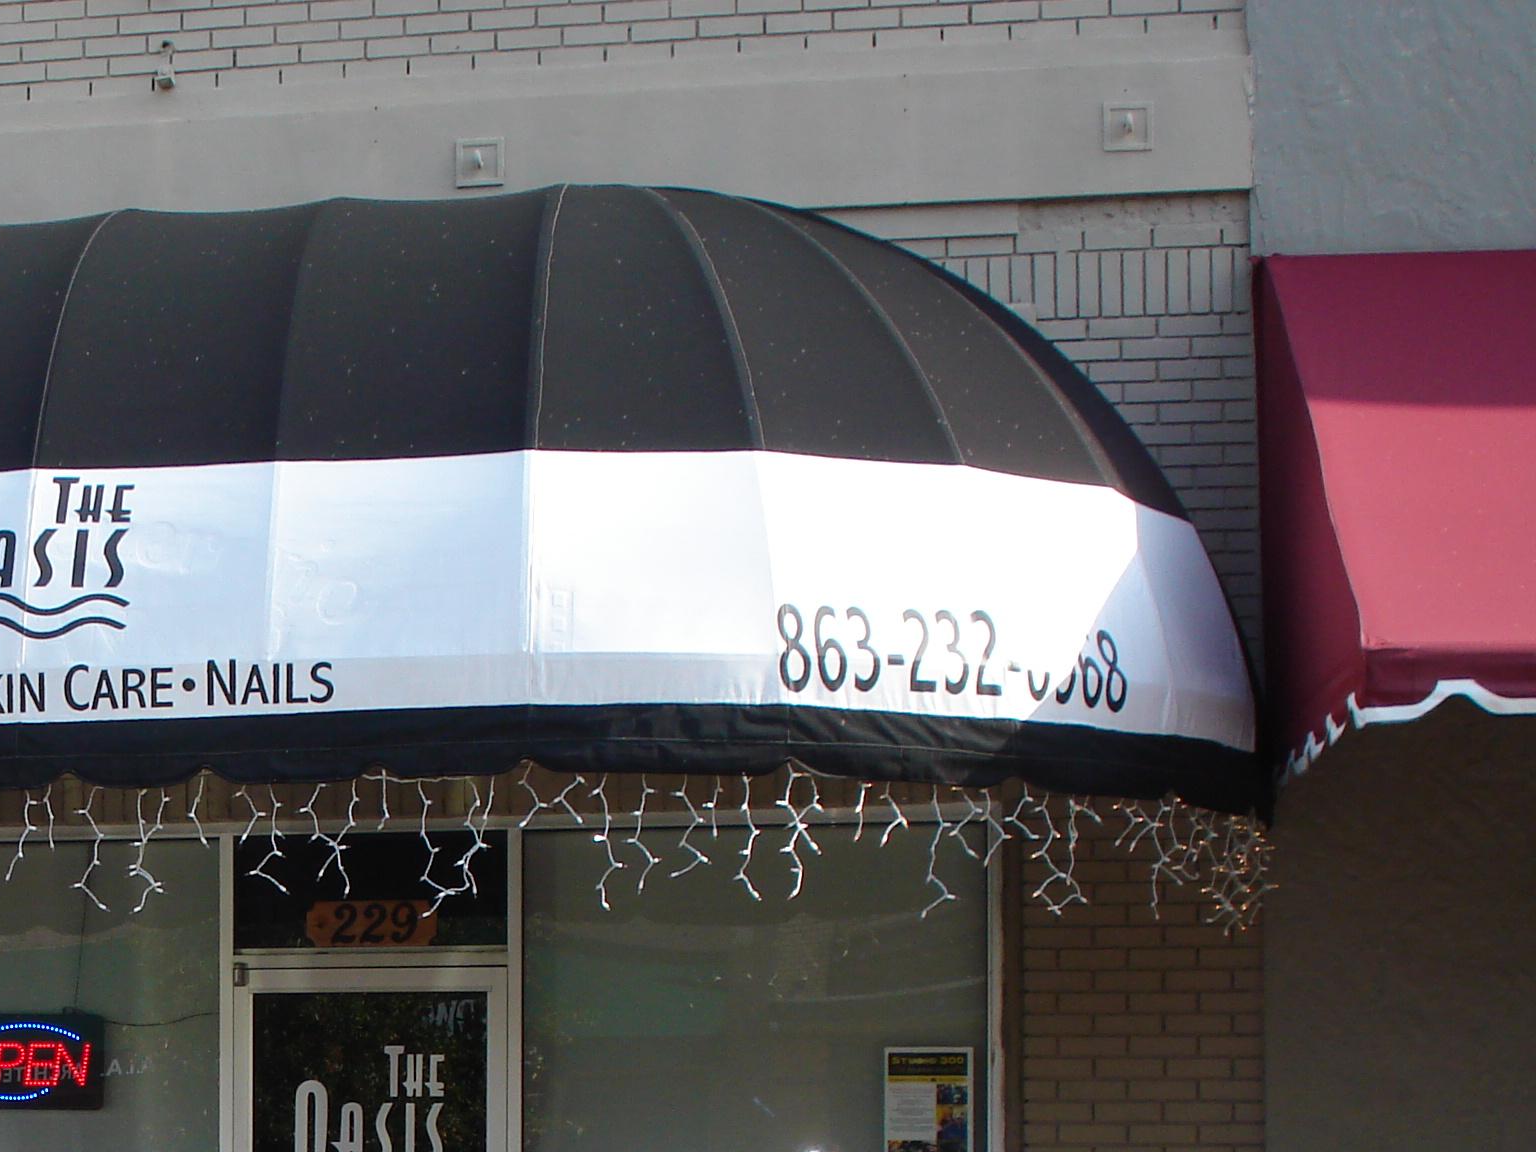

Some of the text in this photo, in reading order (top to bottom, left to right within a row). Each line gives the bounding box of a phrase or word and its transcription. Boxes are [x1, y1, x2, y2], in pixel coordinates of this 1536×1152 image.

[53, 476, 135, 524] THE
[63, 664, 174, 712] CARE
[206, 658, 335, 706] NAILS
[331, 902, 418, 944] 229
[383, 1044, 446, 1098] THE
